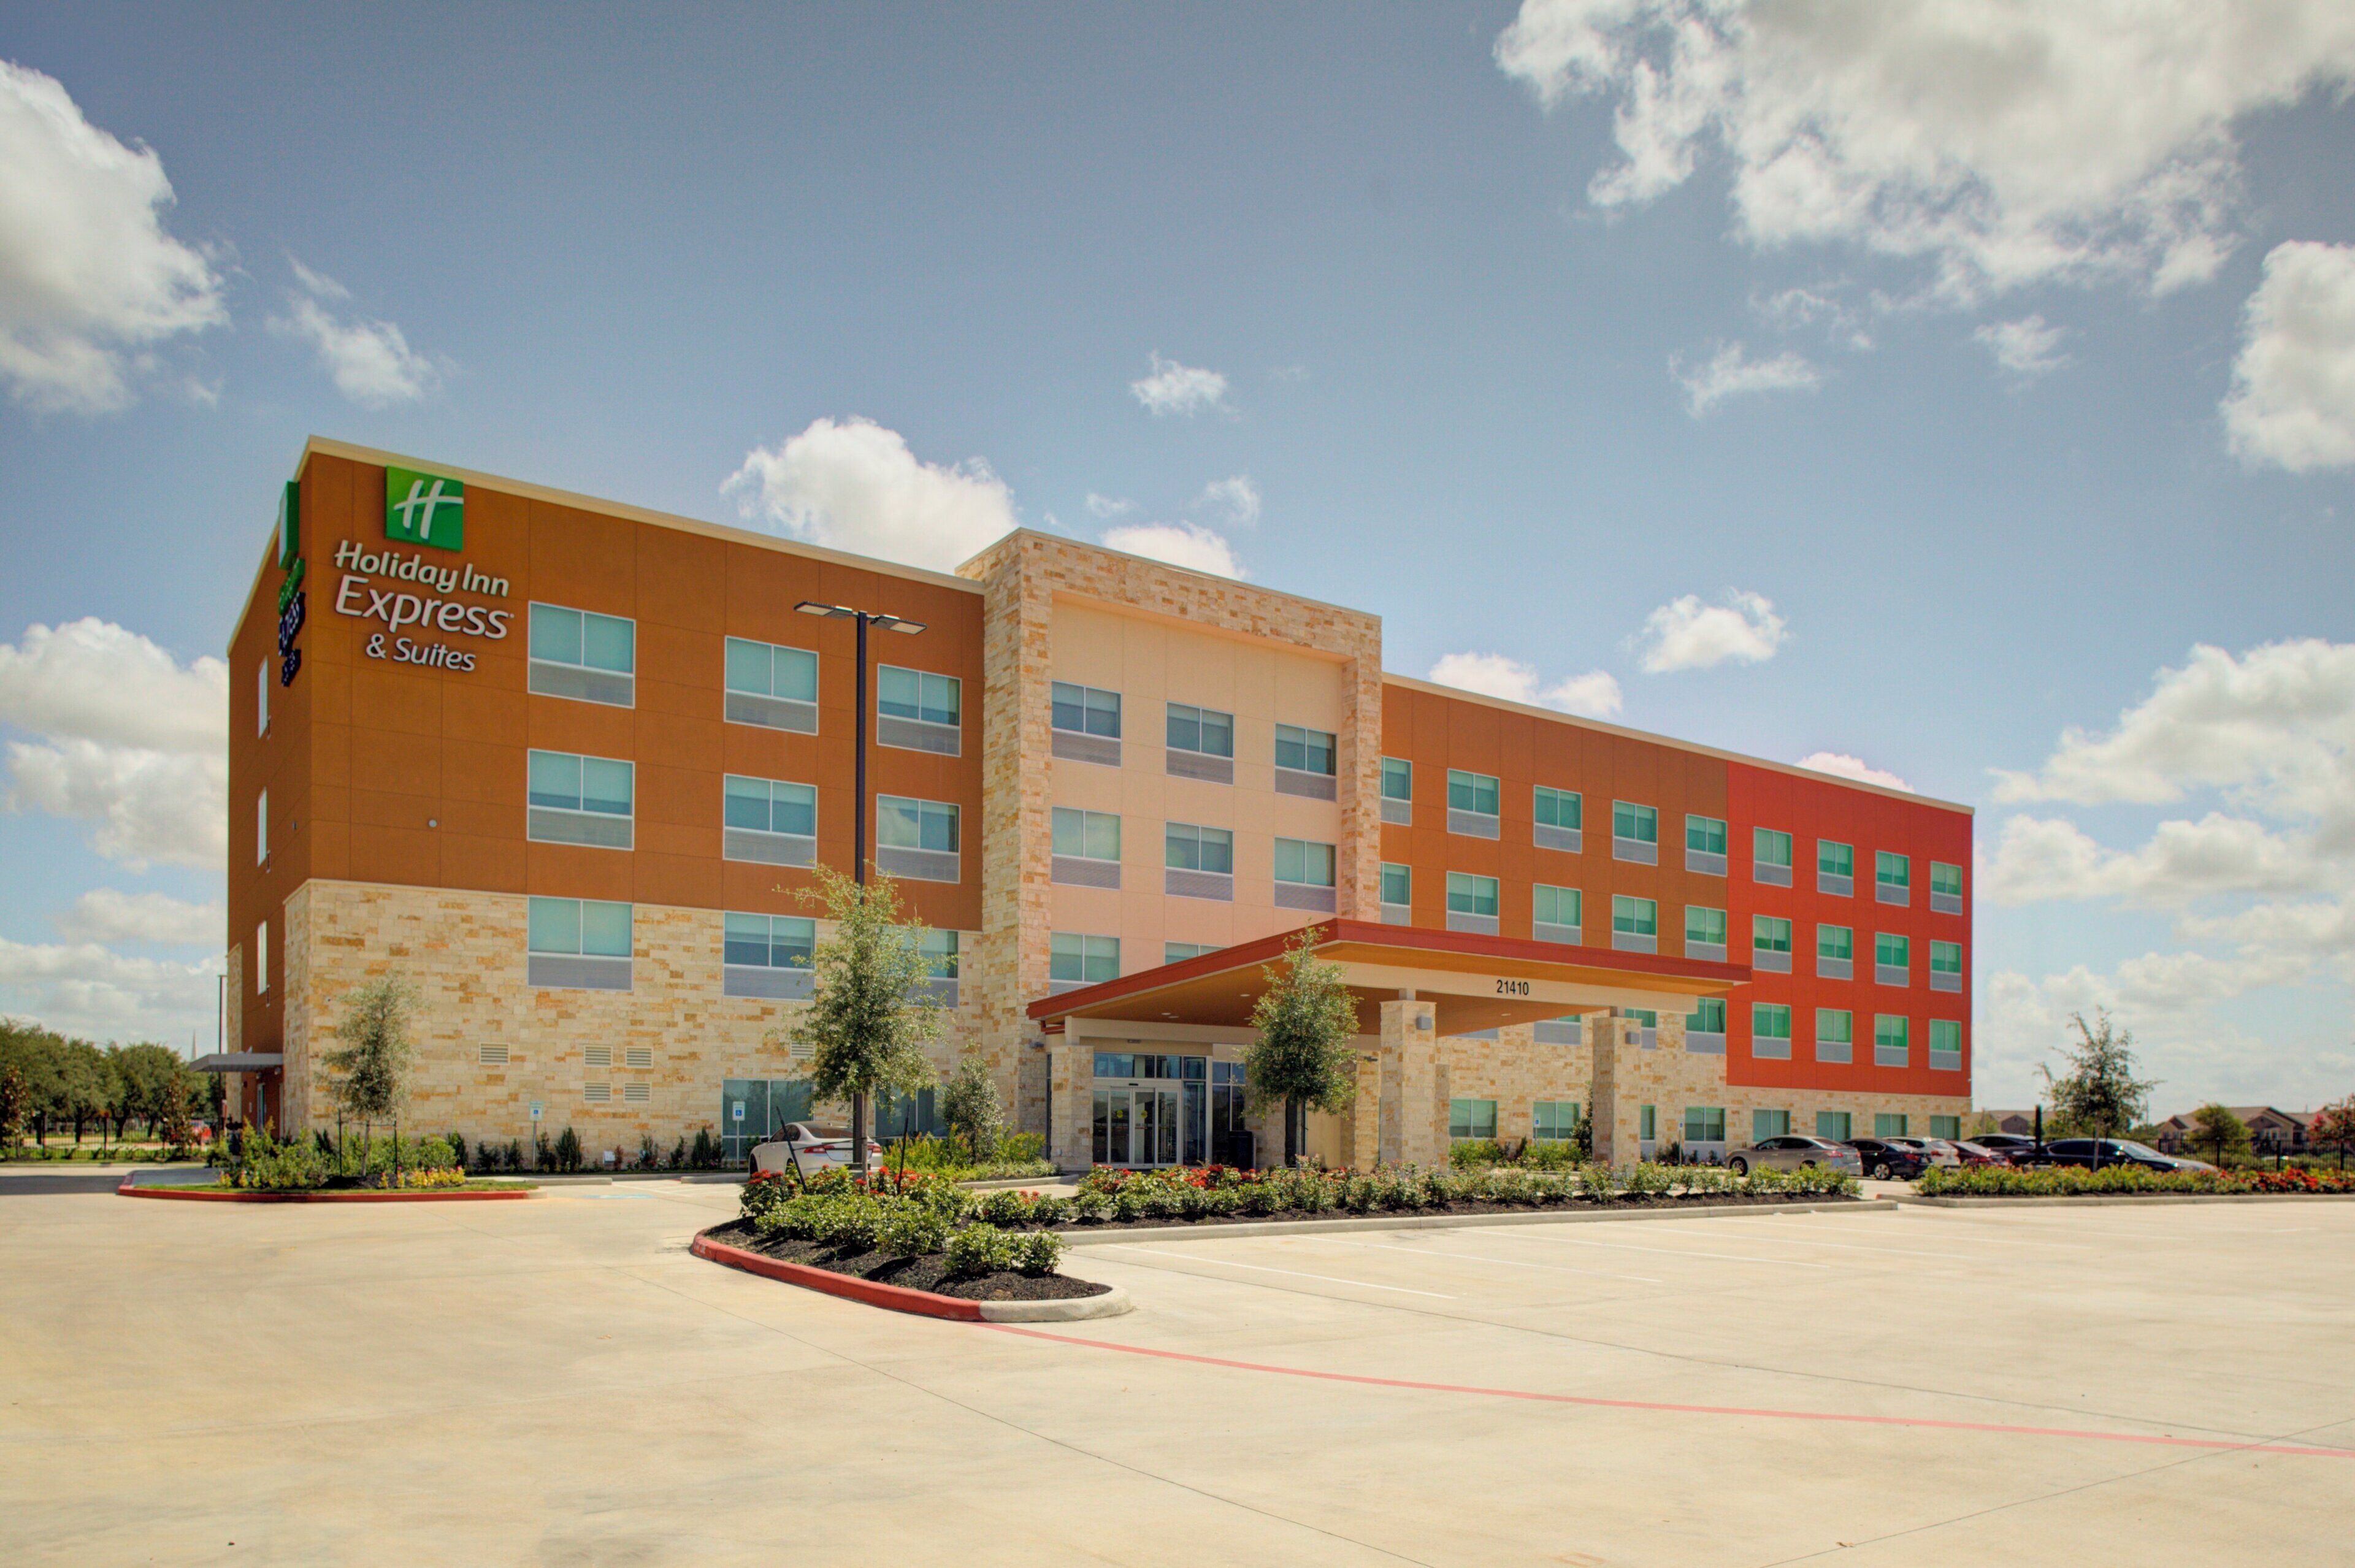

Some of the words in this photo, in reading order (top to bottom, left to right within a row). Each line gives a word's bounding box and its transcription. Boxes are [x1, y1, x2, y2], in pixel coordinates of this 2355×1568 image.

[334, 540, 458, 594] Holiday
[462, 563, 510, 597] Inn
[335, 574, 508, 639] Express
[366, 633, 386, 659] &
[392, 637, 477, 672] Suites
[1496, 979, 1529, 996] 21410
